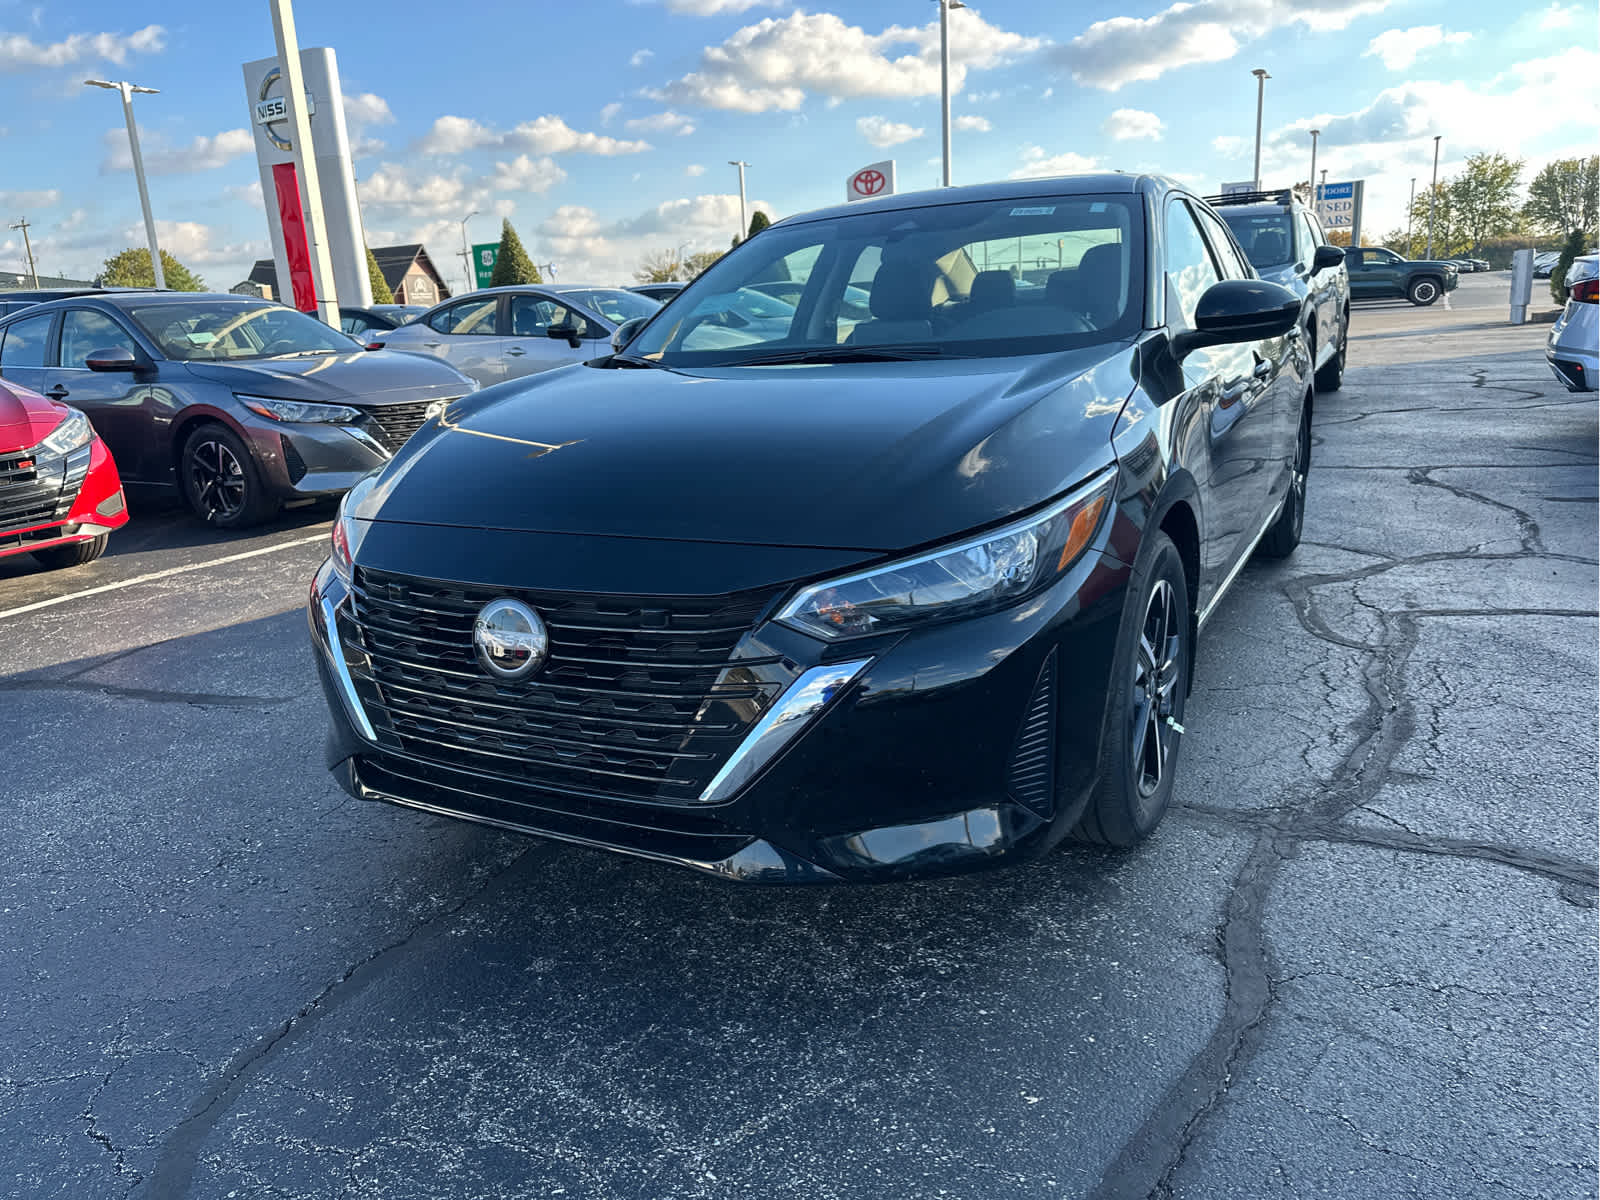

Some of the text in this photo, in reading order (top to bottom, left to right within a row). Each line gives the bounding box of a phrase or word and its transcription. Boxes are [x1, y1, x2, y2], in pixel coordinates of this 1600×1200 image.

[257, 102, 286, 118] NISS
[1321, 186, 1351, 195] OORE
[1326, 215, 1351, 225] ARS
